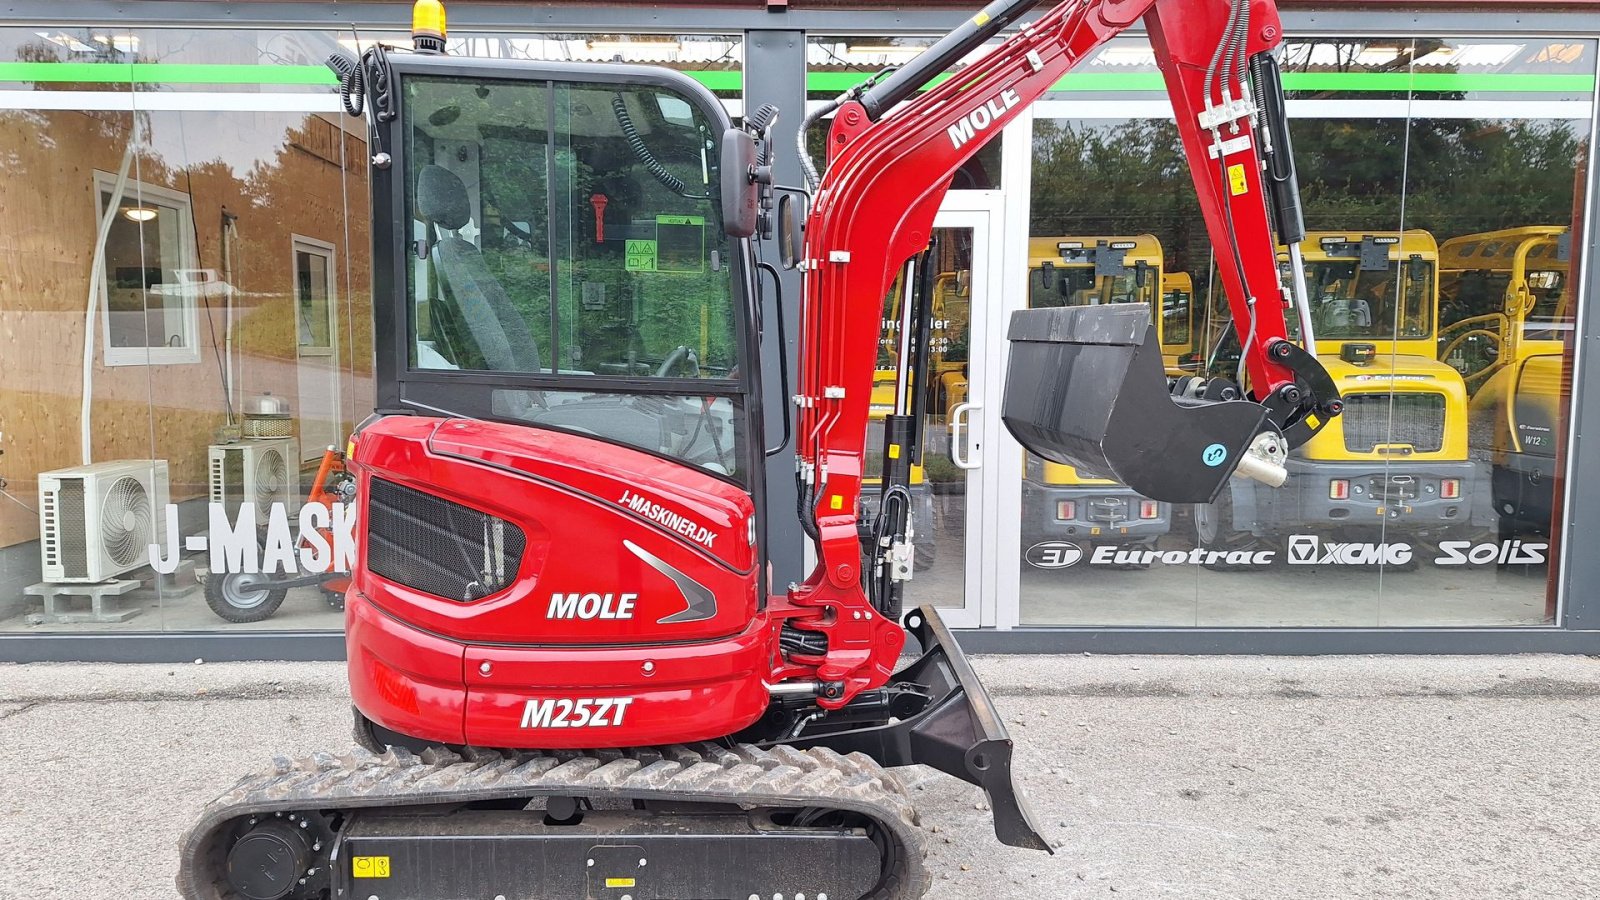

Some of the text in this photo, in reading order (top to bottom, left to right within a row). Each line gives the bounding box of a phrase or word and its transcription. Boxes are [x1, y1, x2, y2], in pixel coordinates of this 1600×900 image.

[946, 87, 1021, 150] MOLE
[618, 489, 718, 548] J-MASKINER.DK
[1089, 545, 1276, 565] Eurotrac
[1316, 542, 1413, 564] XCMG
[1434, 539, 1549, 565] Solis
[546, 592, 638, 620] MOLE
[520, 696, 634, 729] M25ZT
